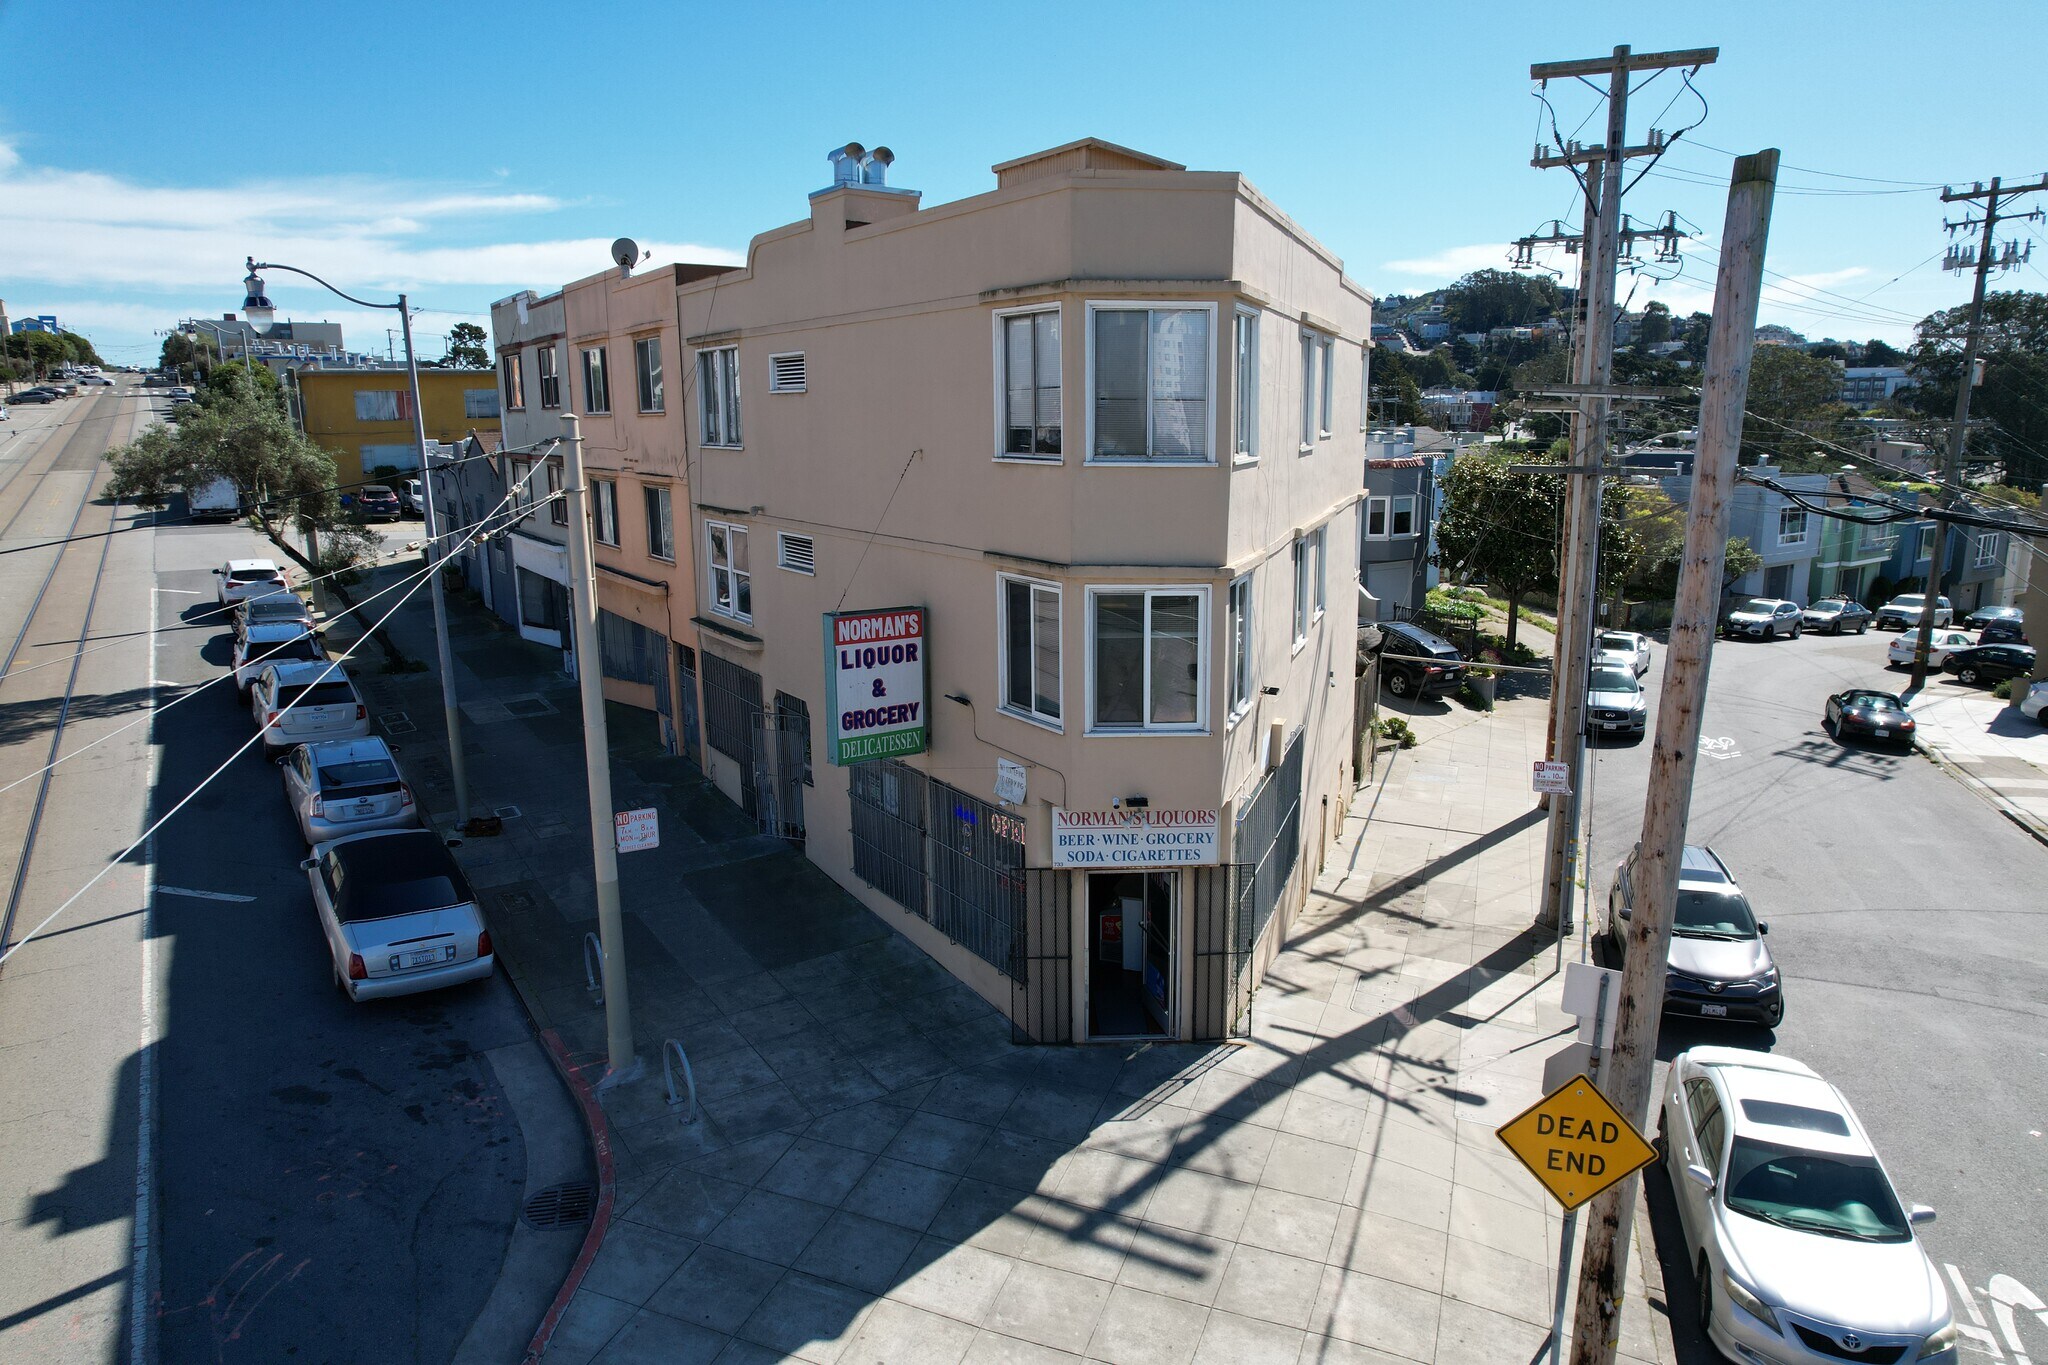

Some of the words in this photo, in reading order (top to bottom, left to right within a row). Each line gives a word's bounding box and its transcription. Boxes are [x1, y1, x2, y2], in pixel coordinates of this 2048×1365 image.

[838, 613, 919, 642] NORMAN'S
[841, 643, 918, 670] LIQUOR
[872, 678, 887, 698] &
[841, 702, 920, 731] GROCERY
[842, 730, 920, 759] DELICATESSEN
[1535, 762, 1544, 771] NO
[1545, 764, 1566, 772] PARKING
[617, 813, 629, 825] NO
[630, 811, 656, 823] PARKING
[1057, 810, 1142, 827] NORMAN'S
[1146, 809, 1217, 828] LIQUORS
[1058, 834, 1096, 846] BEER
[1102, 833, 1140, 846] WINE
[1146, 832, 1216, 846] GROCERY
[1067, 850, 1105, 863] SODA
[1111, 848, 1201, 862] CIGARETTES
[1537, 1113, 1619, 1144] DEAD
[1547, 1148, 1606, 1177] END
